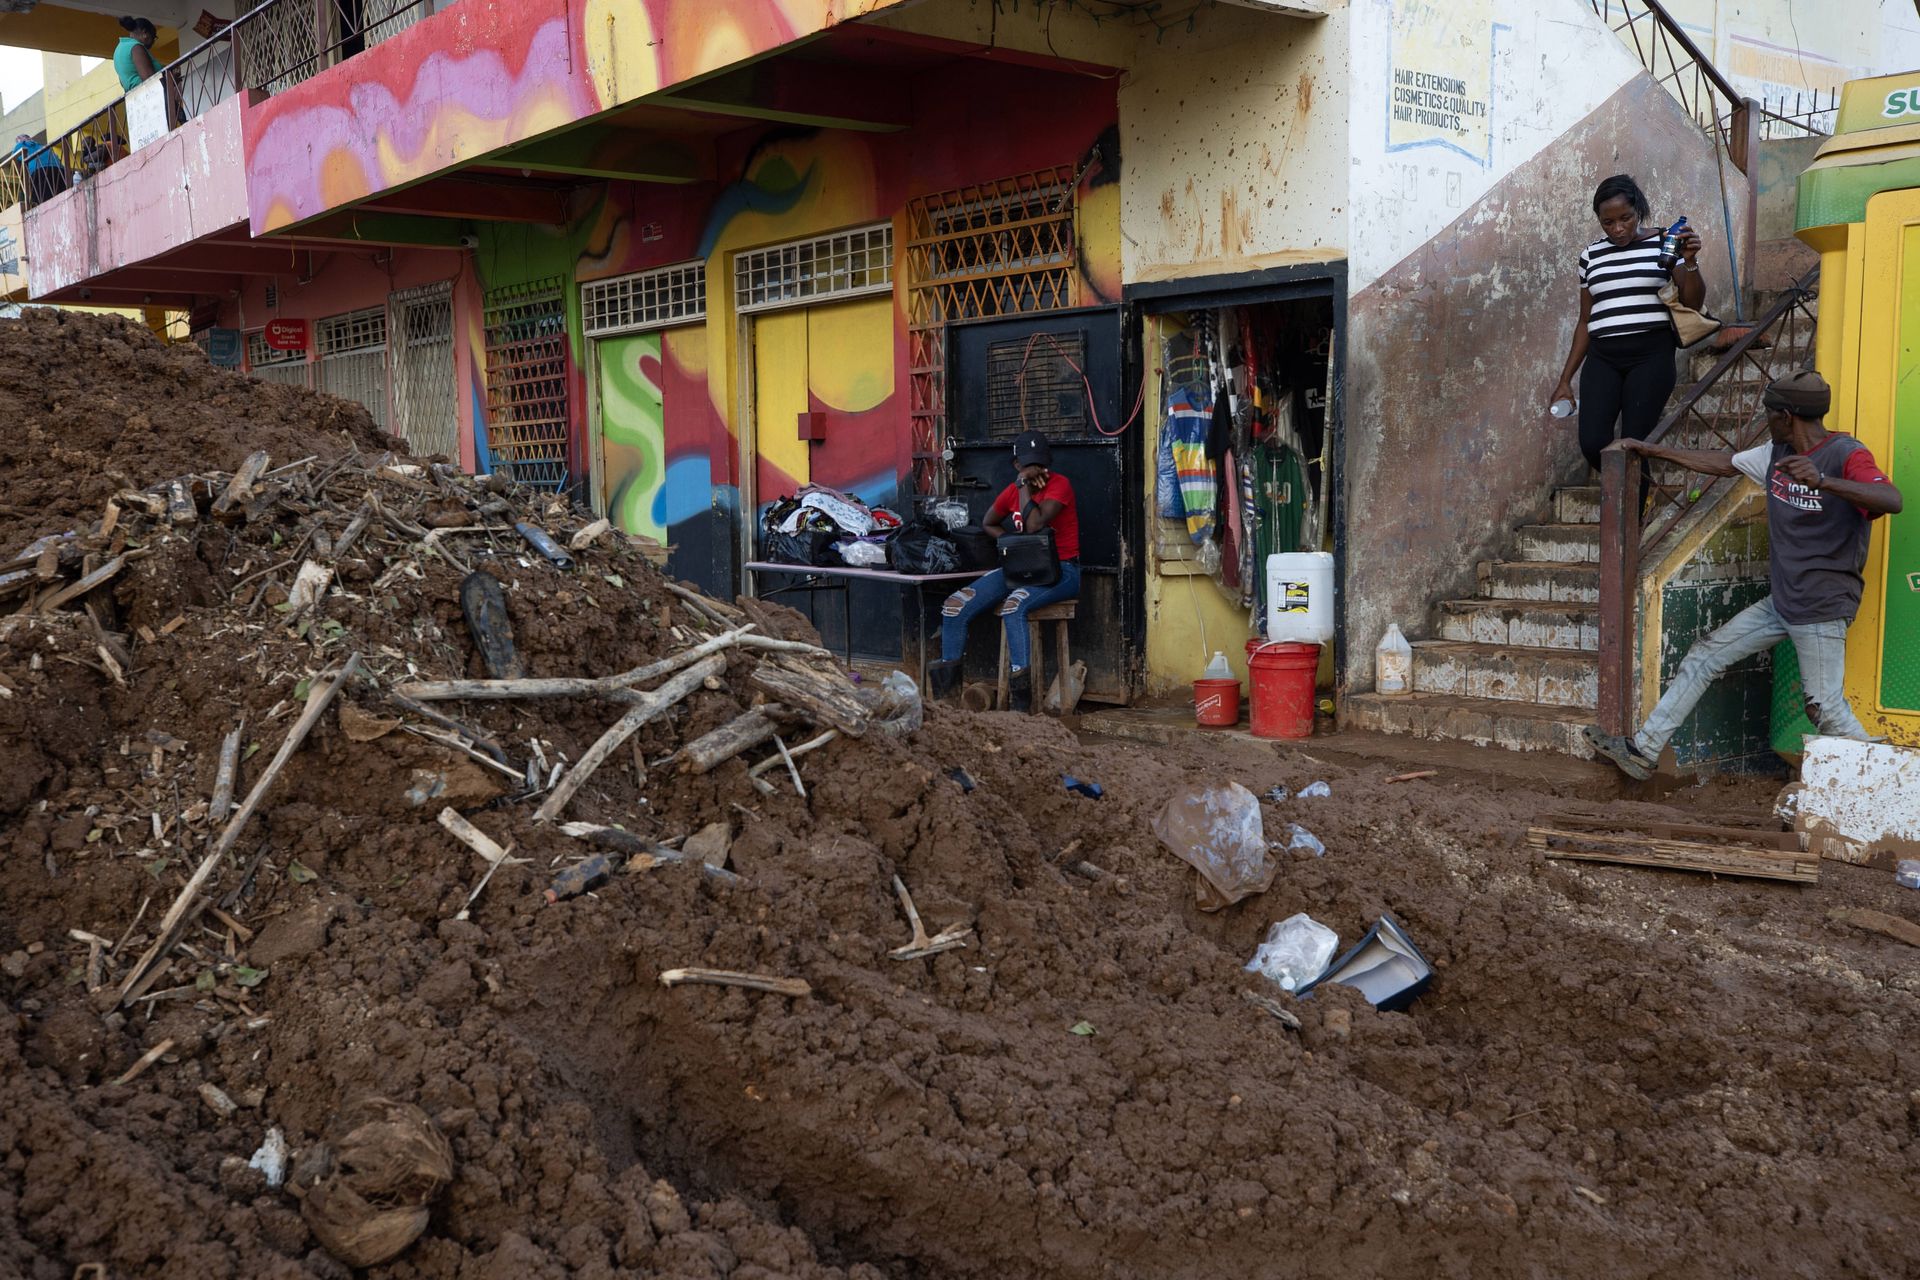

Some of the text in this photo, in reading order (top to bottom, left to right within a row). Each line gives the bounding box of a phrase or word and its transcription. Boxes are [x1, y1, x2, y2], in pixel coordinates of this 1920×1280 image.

[1395, 67, 1466, 96] HAIR EXTENSIONS
[1393, 104, 1413, 123] HAIR
[1394, 86, 1442, 110] COSMETICS
[1450, 97, 1486, 118] QUALITY
